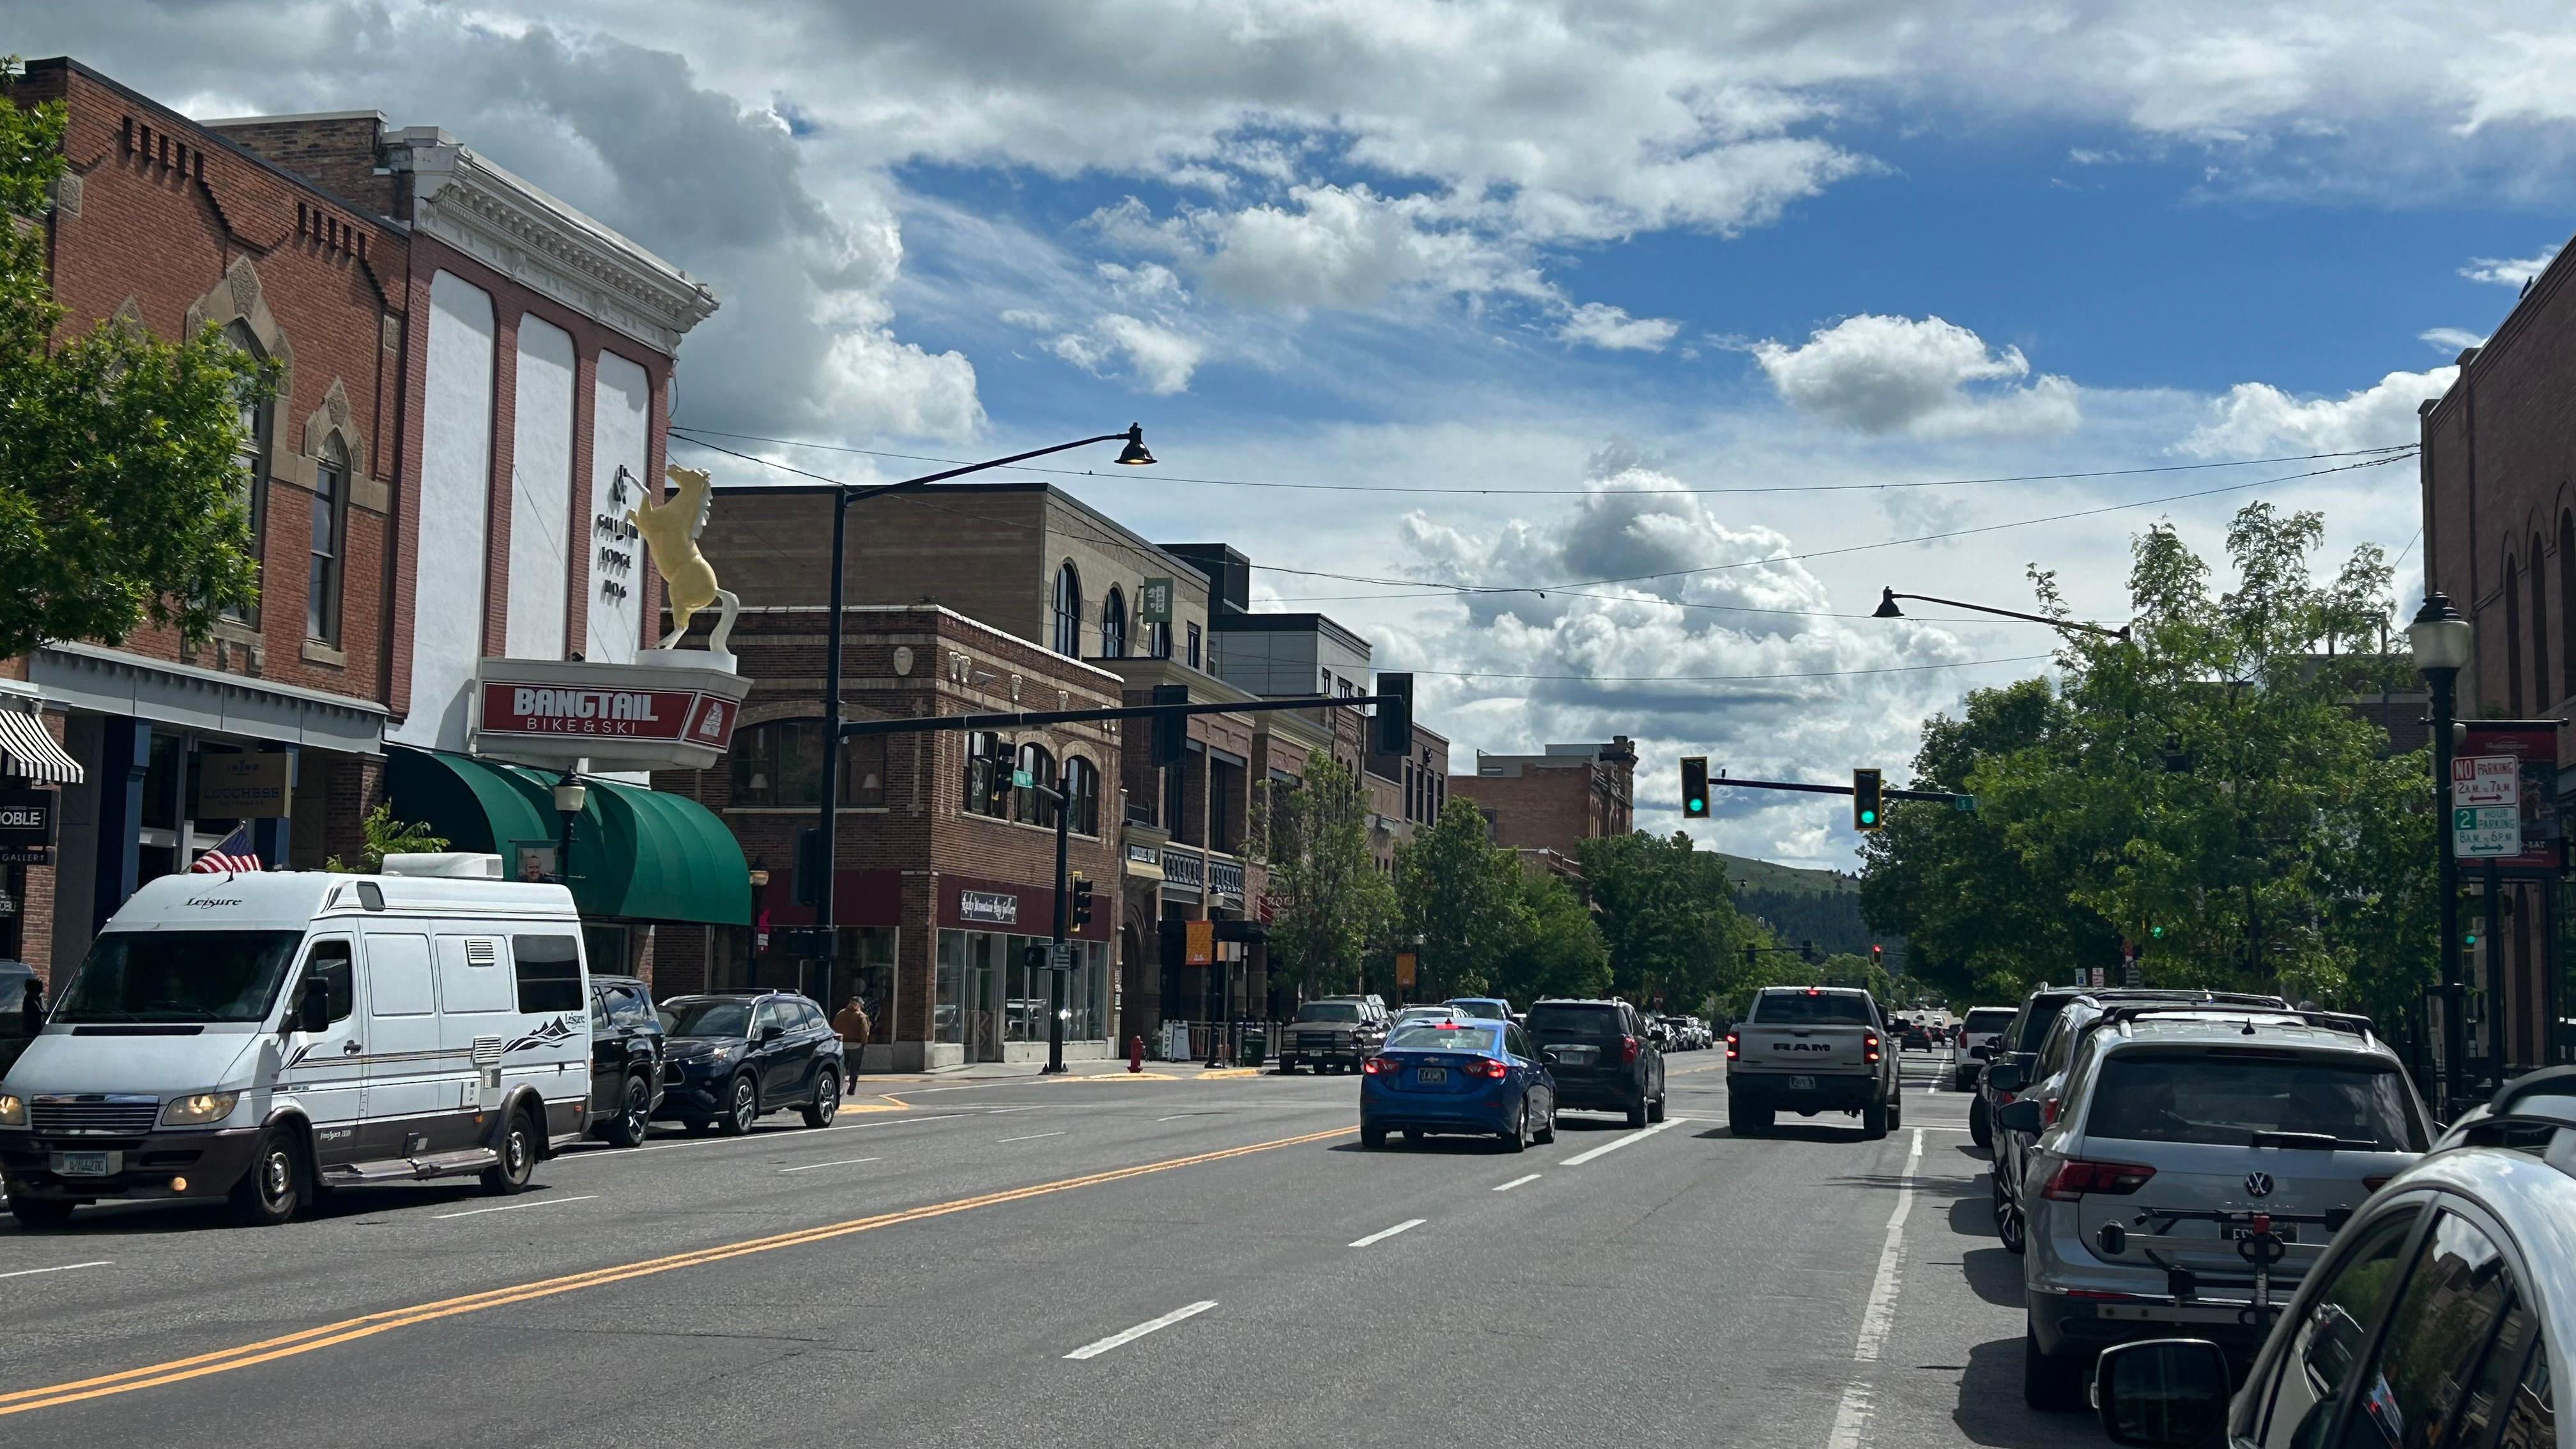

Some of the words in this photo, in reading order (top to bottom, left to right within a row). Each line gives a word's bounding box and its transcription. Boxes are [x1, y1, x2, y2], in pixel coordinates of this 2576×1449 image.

[514, 688, 658, 721] BANGTAIL
[2456, 760, 2472, 779] NO
[2478, 762, 2513, 775] PARKING
[204, 787, 280, 799] LUCCHESE
[0, 811, 41, 825] OBLE
[2460, 809, 2471, 828] 2
[2478, 819, 2515, 829] PARKING
[2, 853, 45, 862] GALLERY
[184, 896, 242, 909] Leisure
[1773, 1043, 1830, 1052] RAM
